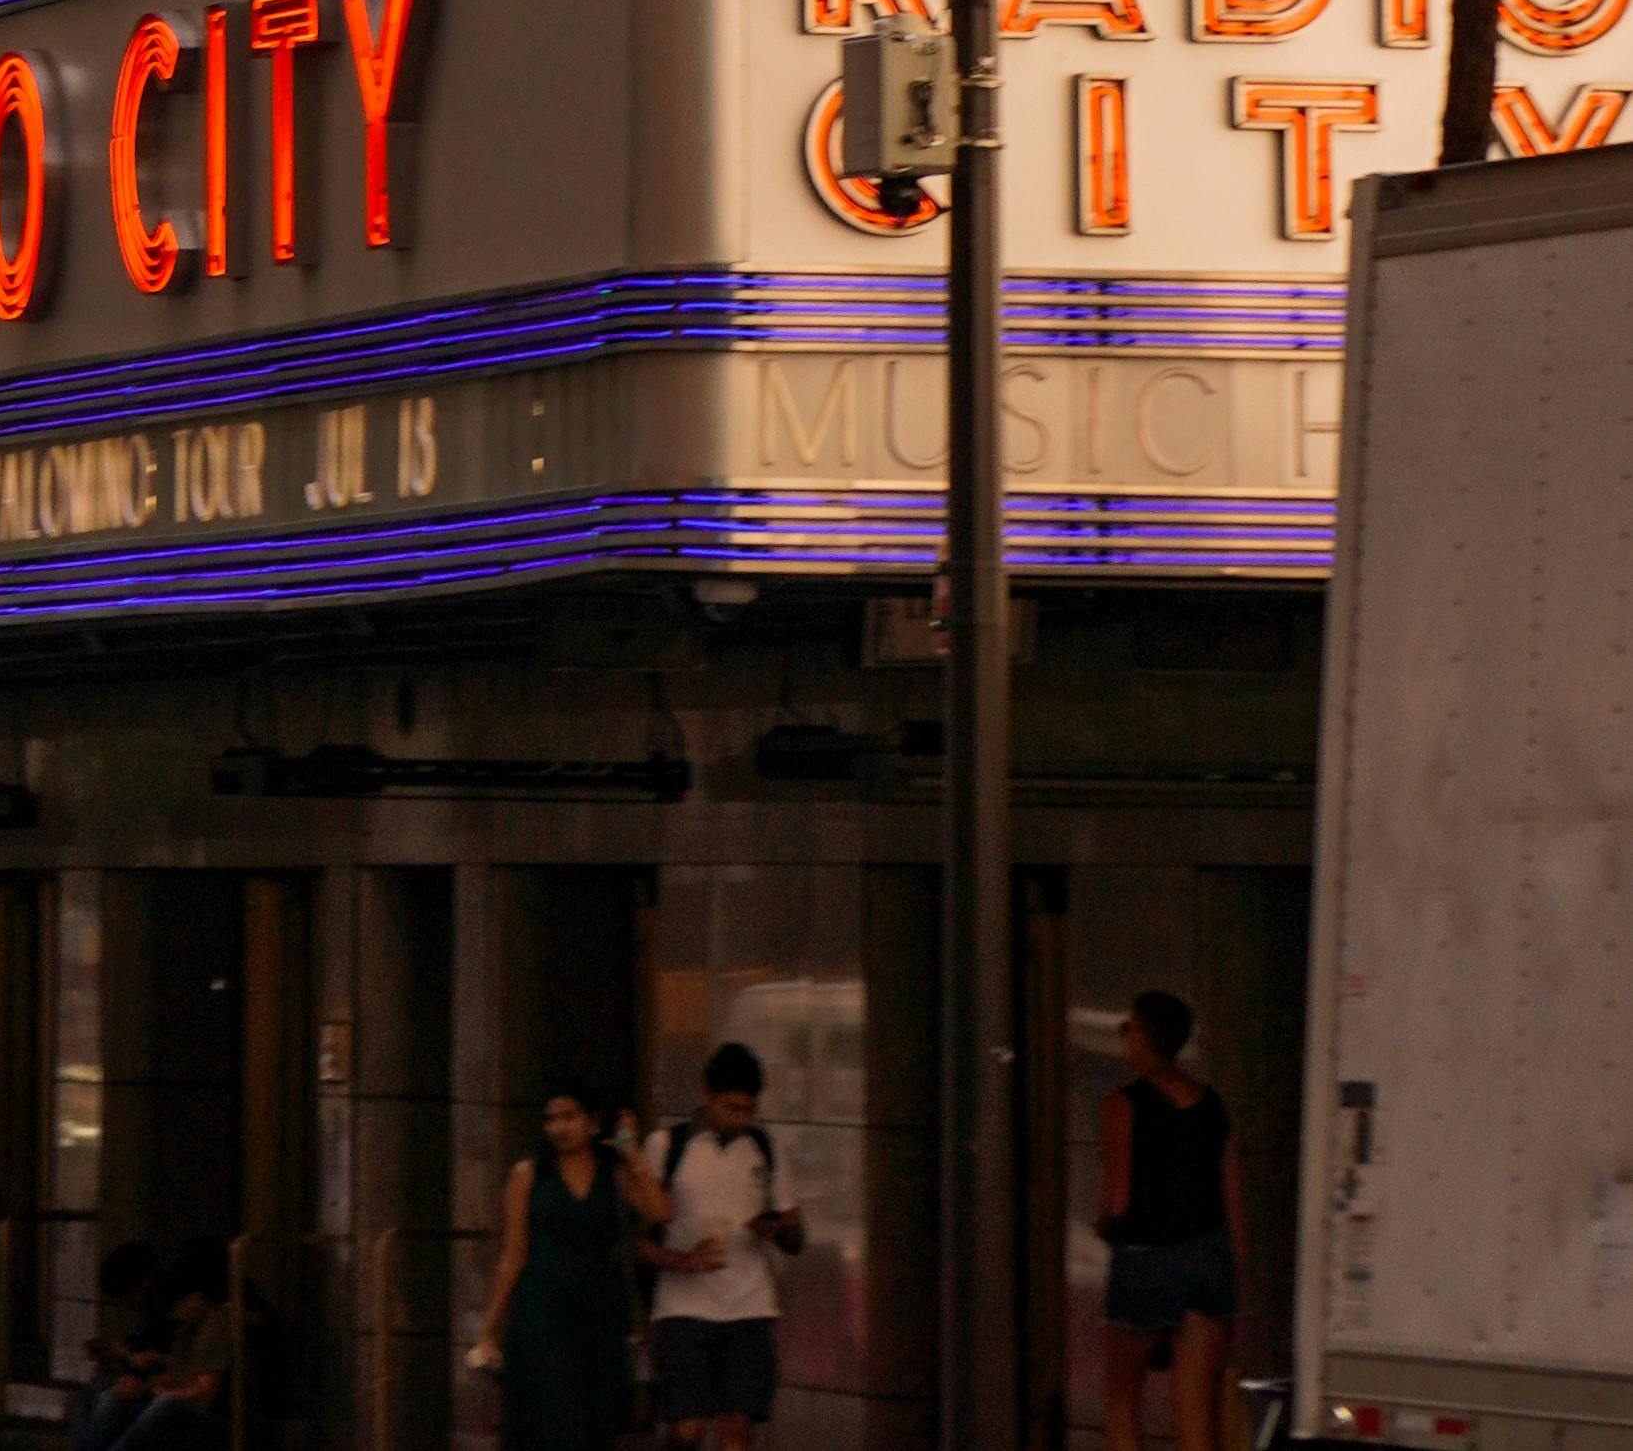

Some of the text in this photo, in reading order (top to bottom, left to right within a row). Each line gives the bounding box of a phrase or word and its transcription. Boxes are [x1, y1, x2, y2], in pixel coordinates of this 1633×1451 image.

[172, 421, 266, 522] TOUR
[305, 406, 373, 511] JUL
[758, 358, 1216, 477] MUSIC
